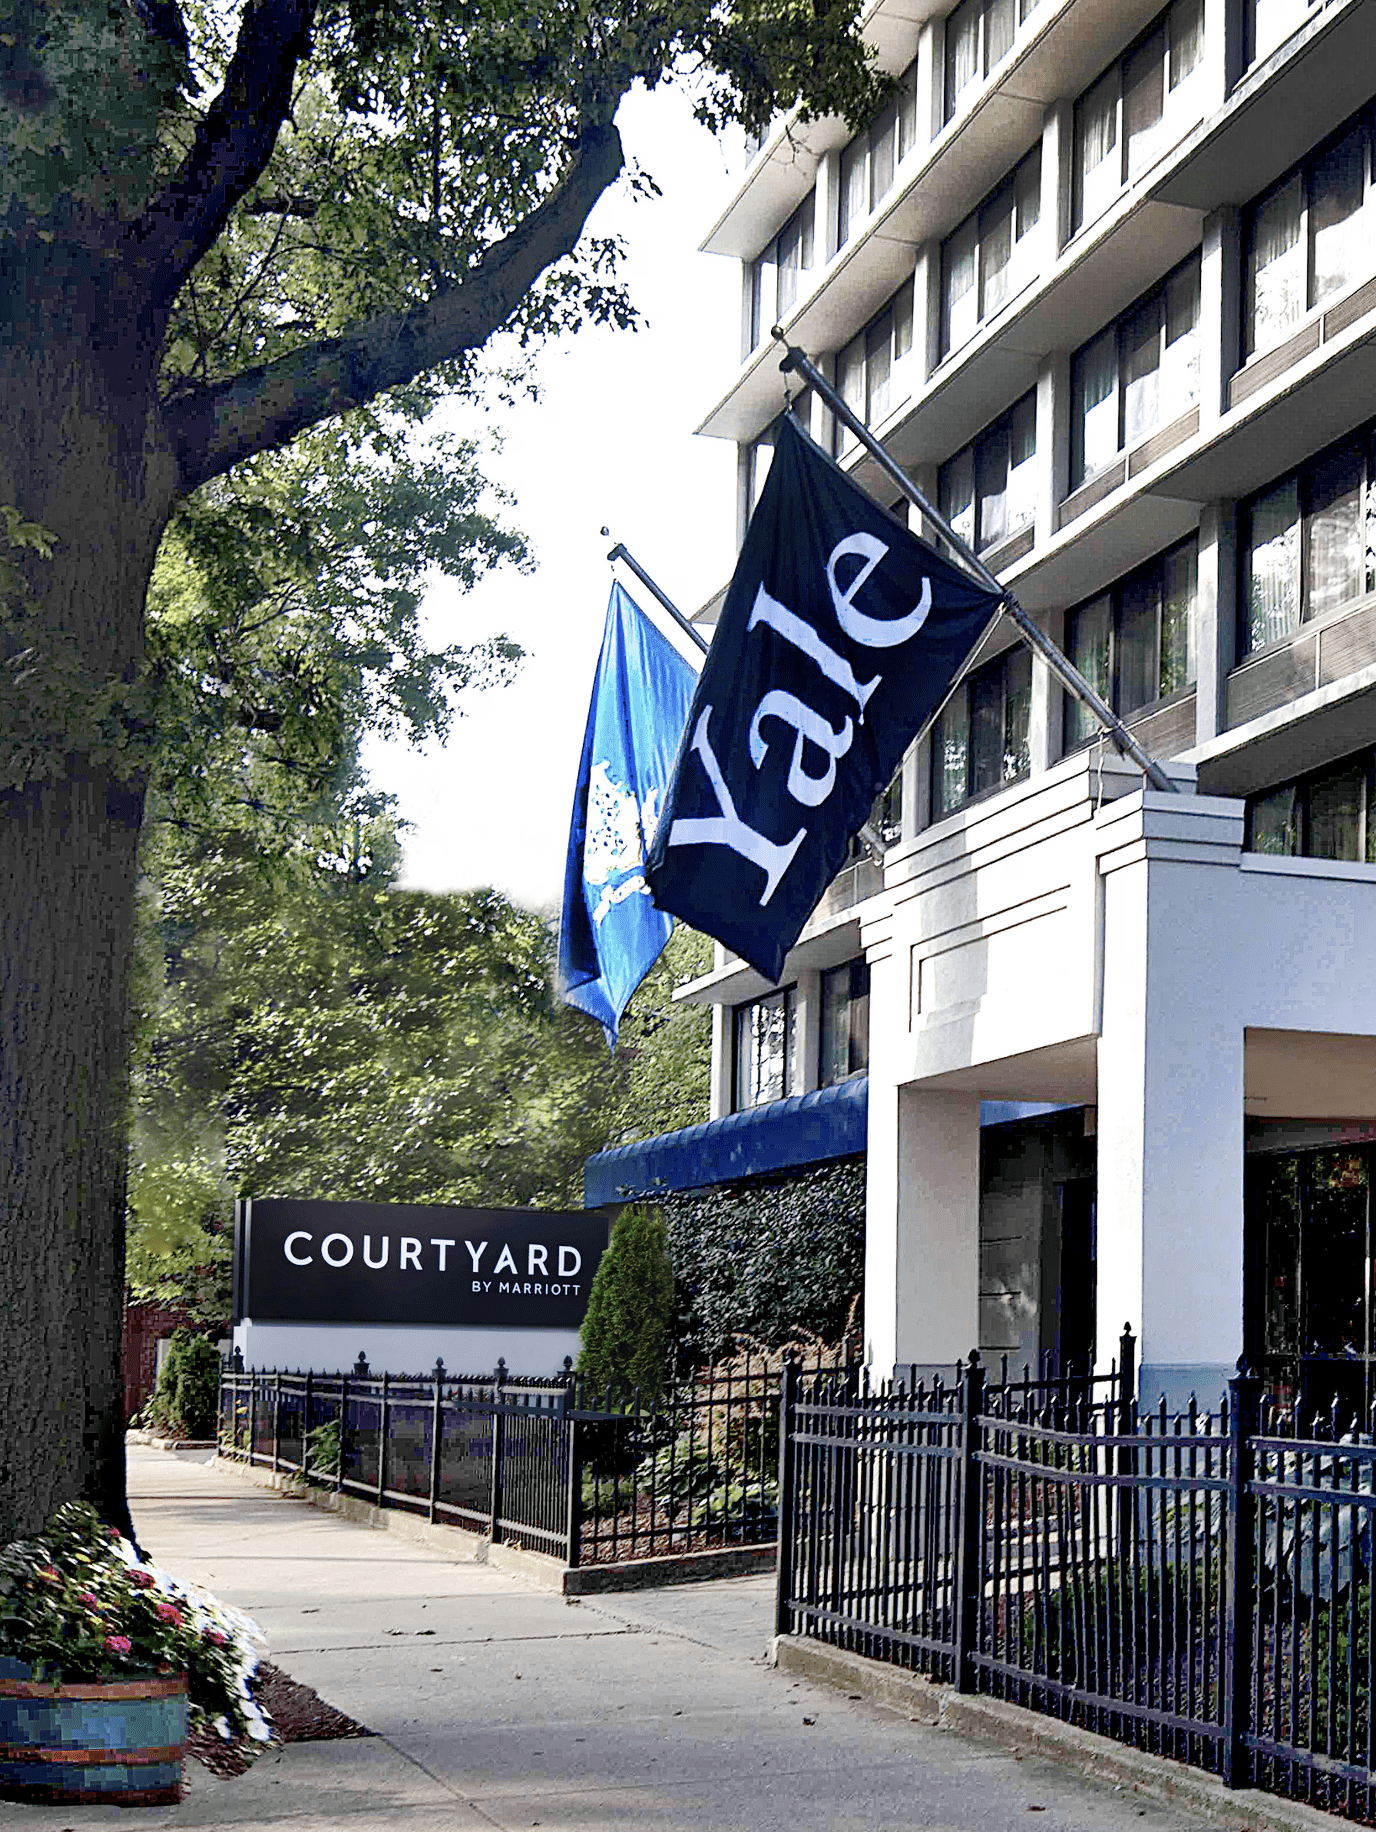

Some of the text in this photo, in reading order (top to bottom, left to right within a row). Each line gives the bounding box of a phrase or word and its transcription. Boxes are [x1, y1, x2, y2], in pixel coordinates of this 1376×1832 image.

[668, 531, 933, 906] Yale
[283, 1230, 582, 1278] COURTYARD
[471, 1280, 581, 1296] BY MARRIOTT
